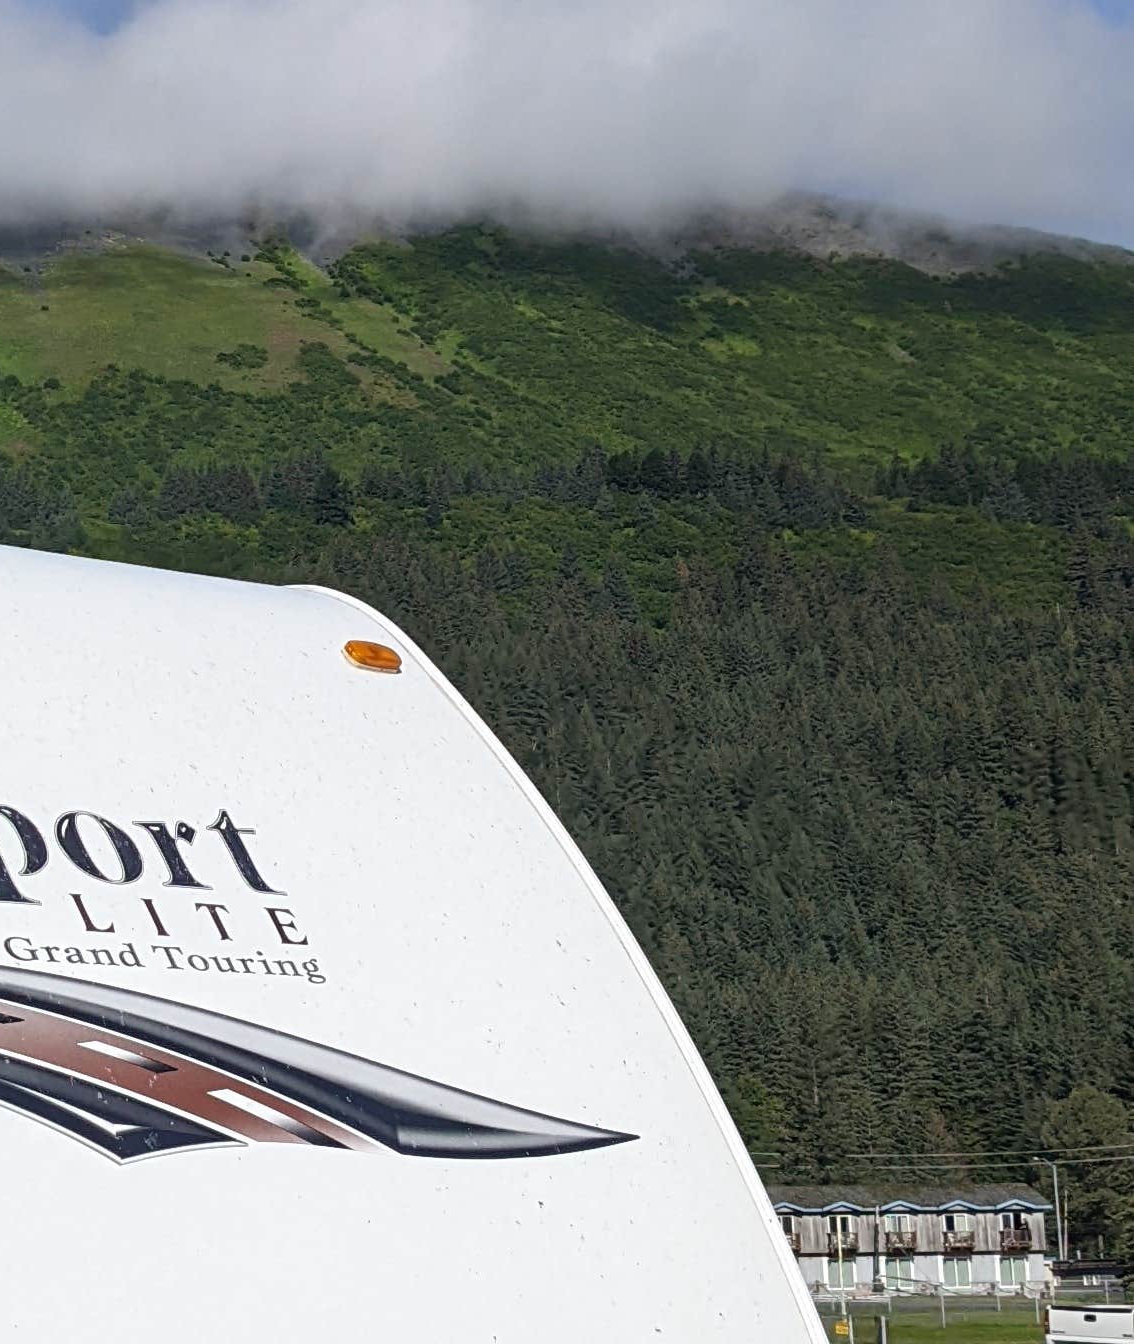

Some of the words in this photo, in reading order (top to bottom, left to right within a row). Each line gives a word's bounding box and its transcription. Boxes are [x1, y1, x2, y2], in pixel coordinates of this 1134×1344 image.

[69, 893, 308, 946] LITE
[3, 936, 145, 969] Grand
[151, 944, 327, 984] Touring
